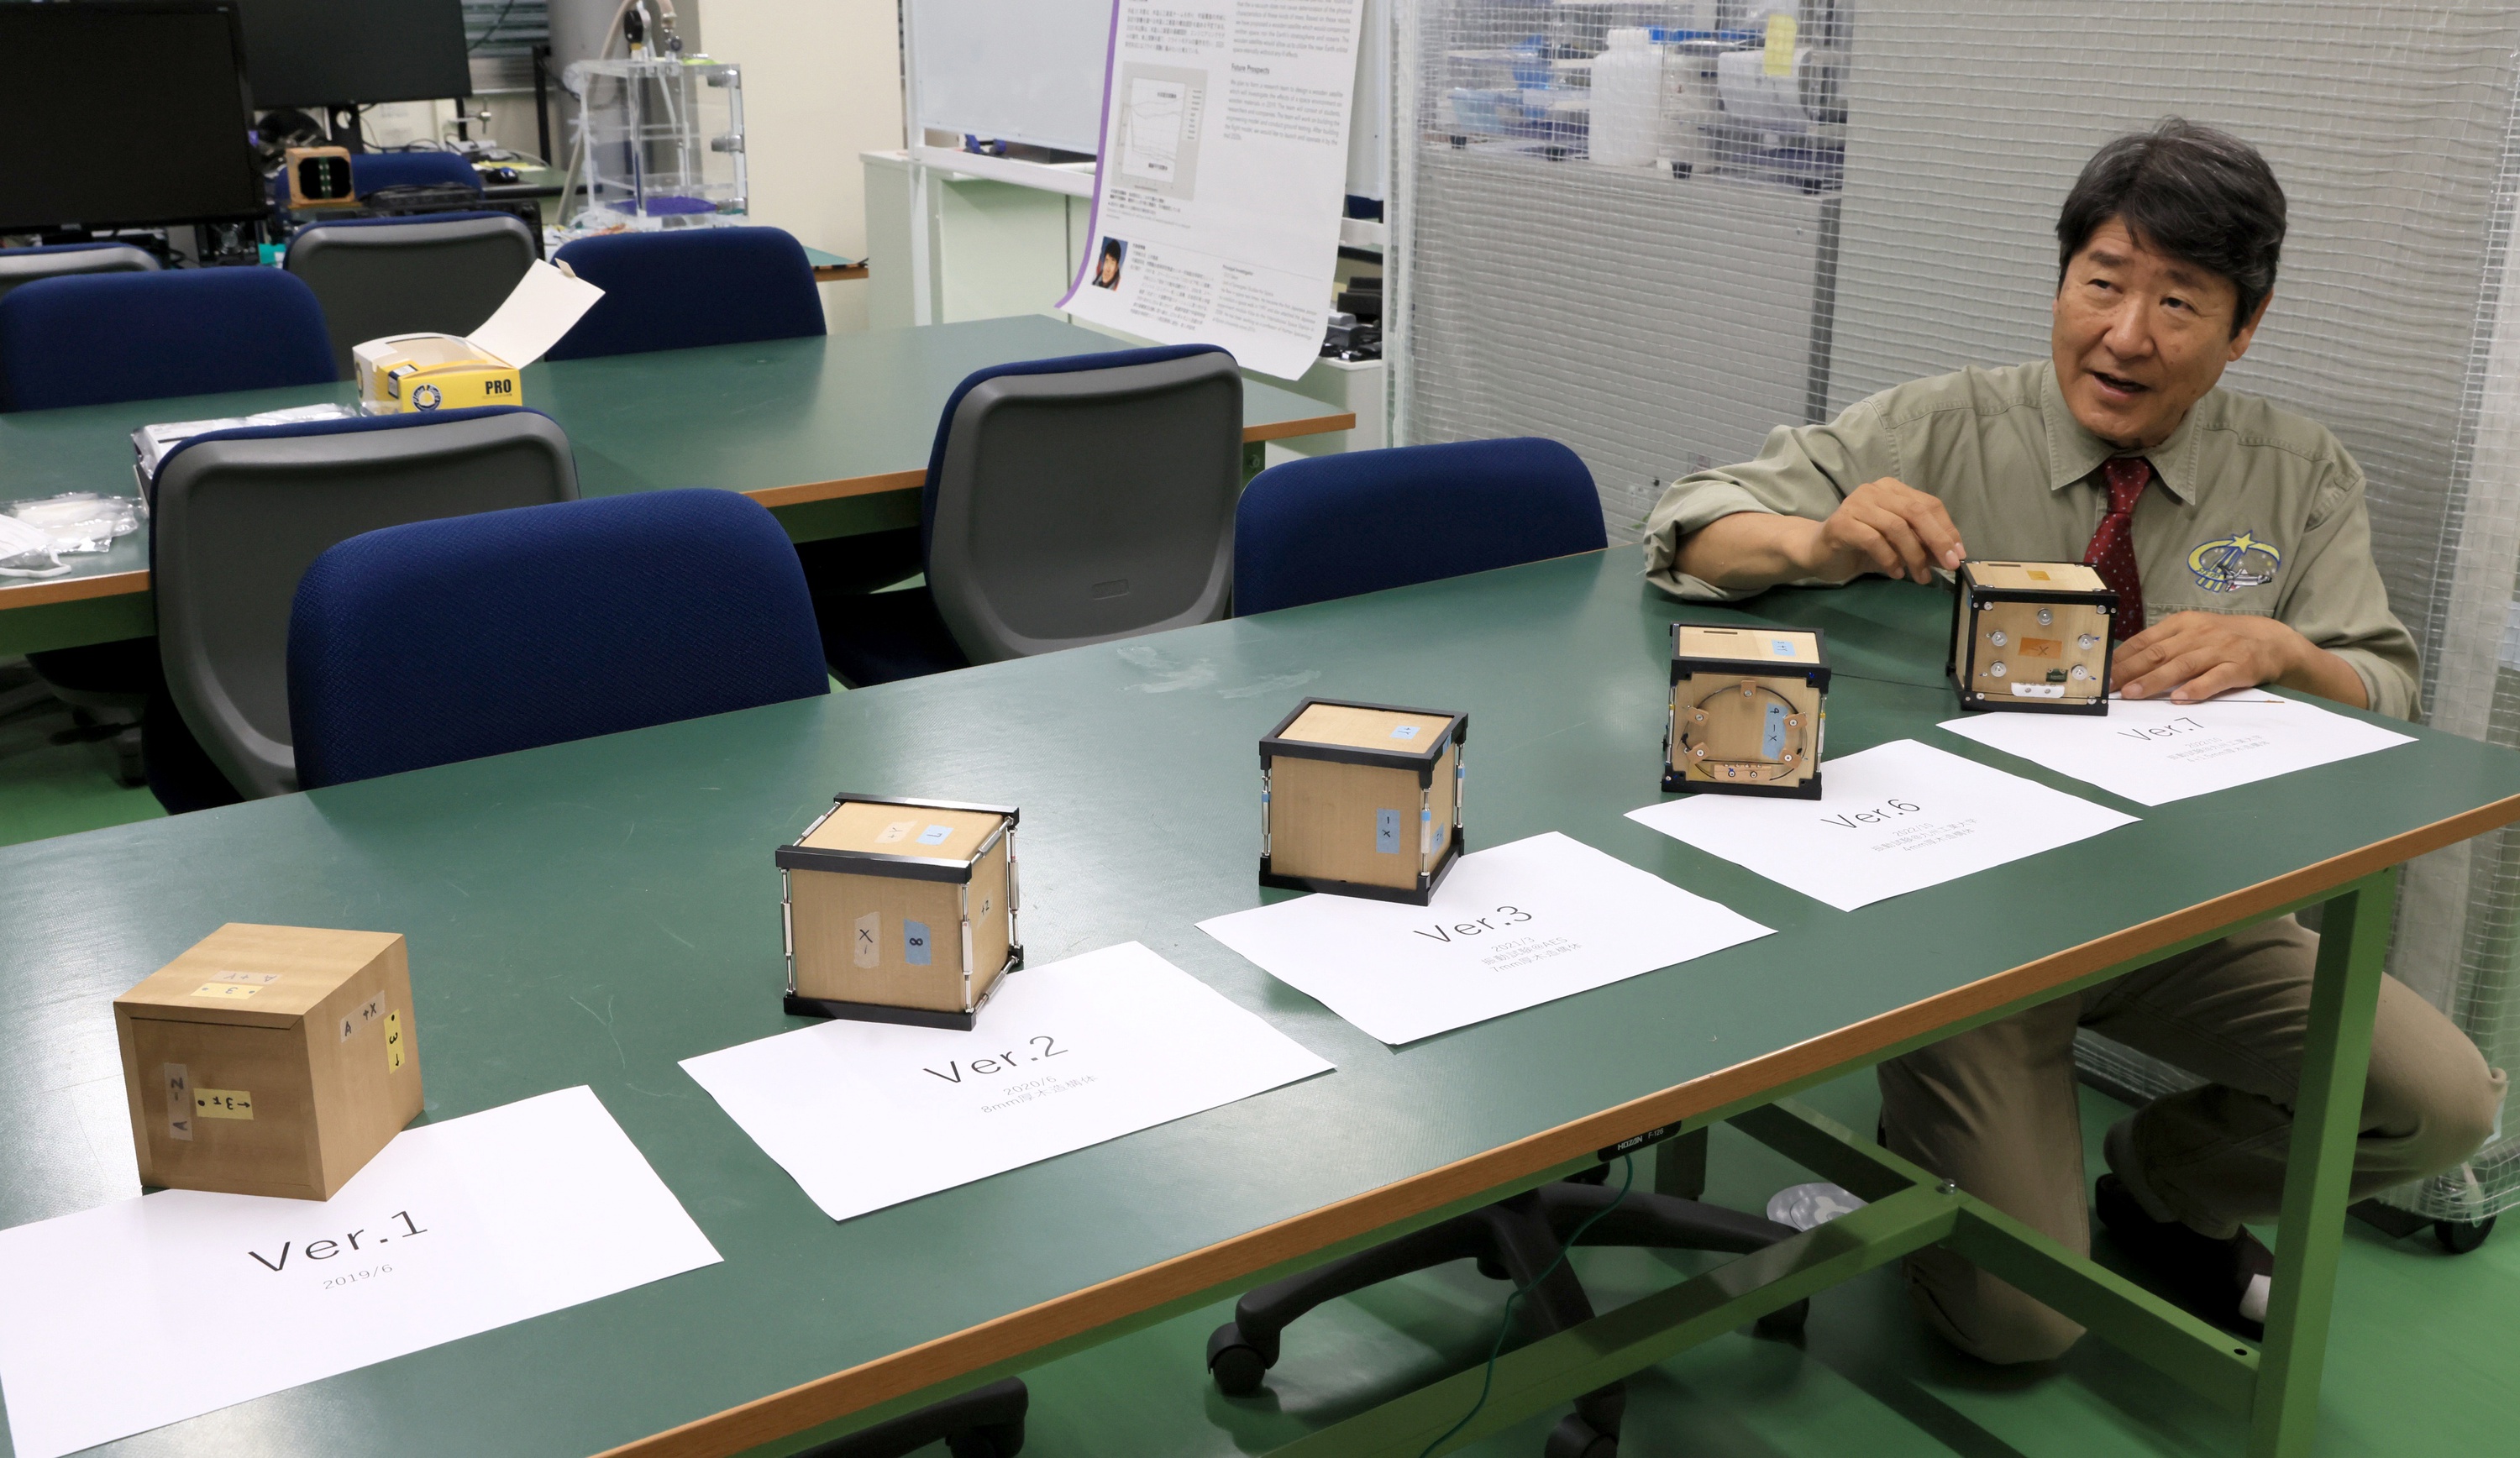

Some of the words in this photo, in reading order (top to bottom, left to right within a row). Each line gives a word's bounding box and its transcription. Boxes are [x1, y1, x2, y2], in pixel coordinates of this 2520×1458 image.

[1247, 65, 1270, 75] Prospects
[485, 379, 511, 395] PRO
[2117, 717, 2204, 741] Ver.7
[1820, 799, 1920, 829] Ver.6
[1382, 816, 1391, 838] -X
[1413, 906, 1532, 943] Ver.3
[909, 938, 923, 946] 8
[1491, 937, 1535, 952] 2021/3
[345, 1021, 351, 1036] A
[363, 1002, 376, 1020] +X
[922, 1036, 1069, 1083] Ver.2
[1003, 1076, 1057, 1095] 2020/6
[173, 1121, 188, 1131] A
[1618, 1136, 1642, 1150] HOZAN
[1648, 1128, 1663, 1139] F-126
[248, 1211, 428, 1272] Ver.1
[323, 1264, 393, 1289] 2019/6
